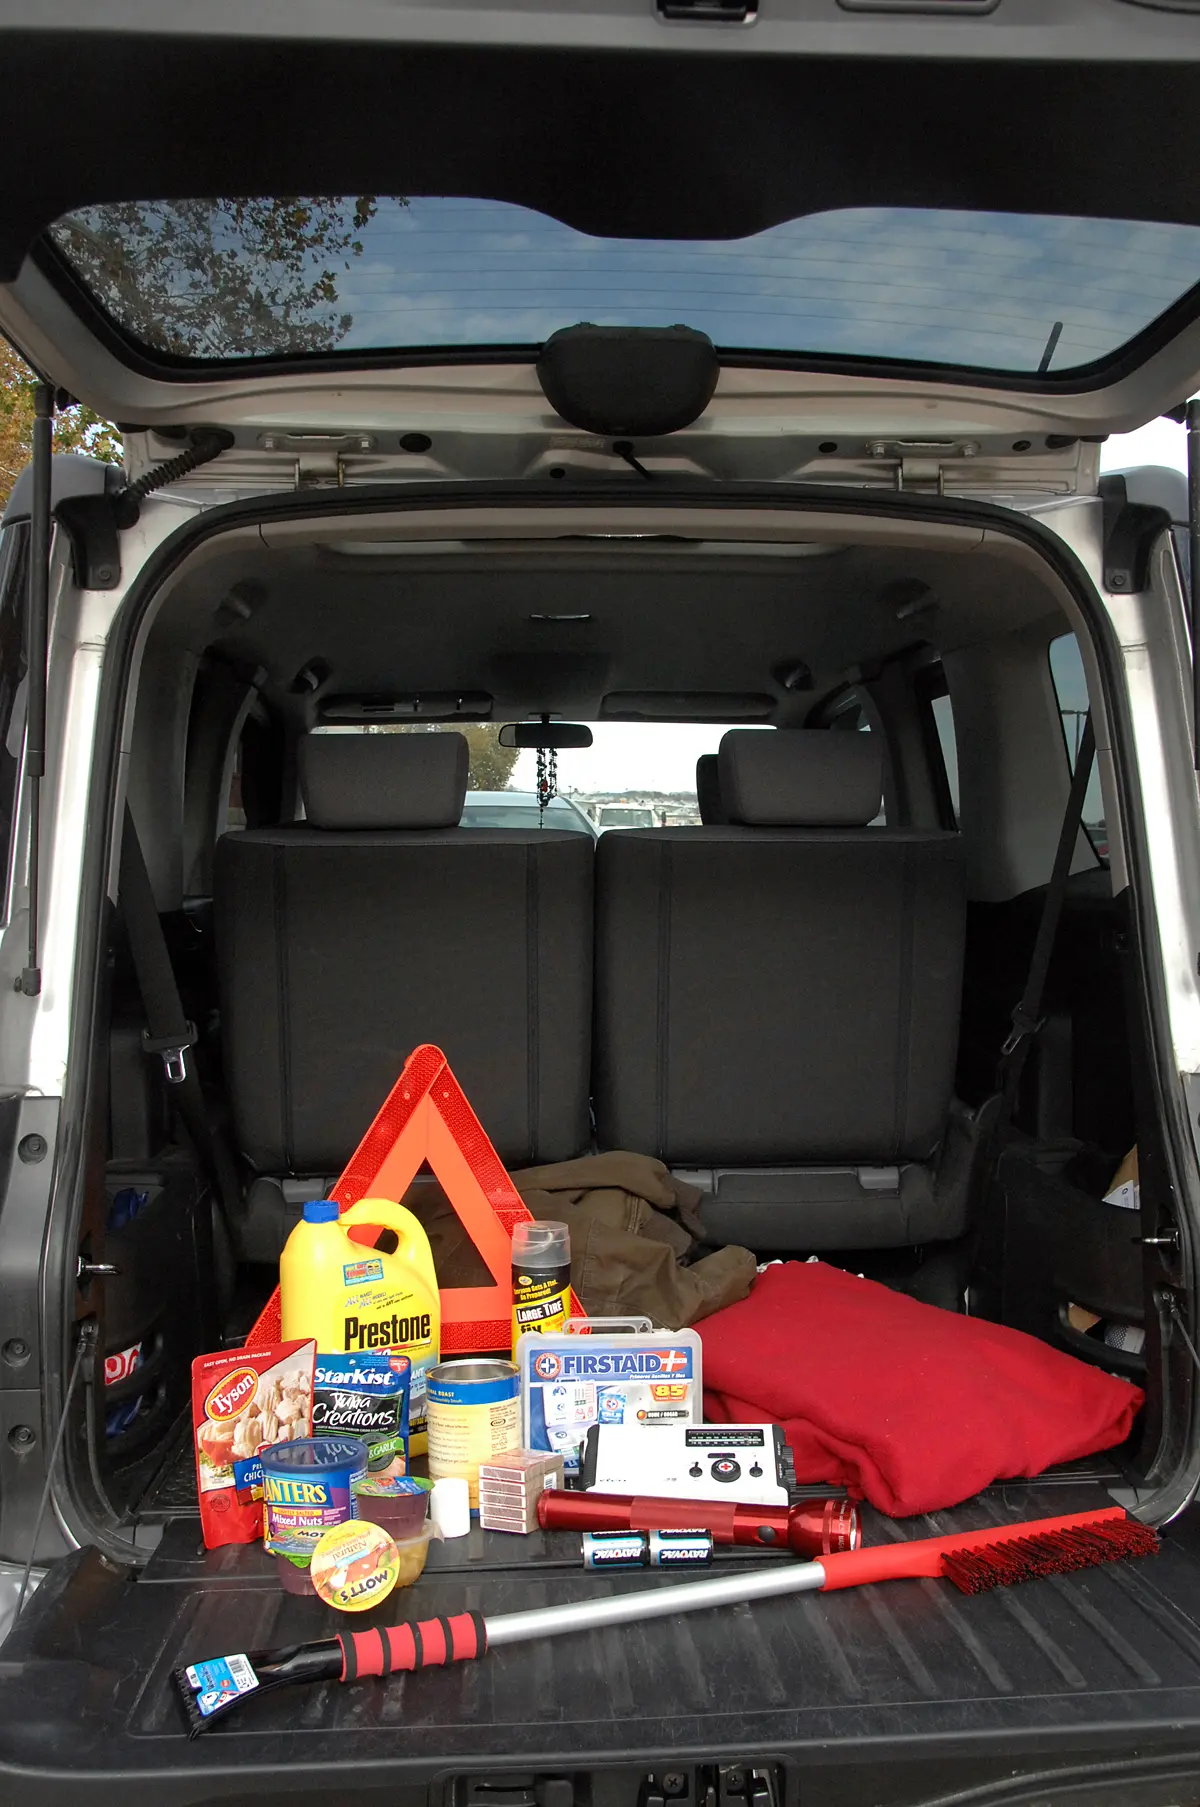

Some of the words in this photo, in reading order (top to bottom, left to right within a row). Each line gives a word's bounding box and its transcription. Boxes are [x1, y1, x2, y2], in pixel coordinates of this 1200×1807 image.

[518, 1308, 543, 1322] LARGE
[543, 1300, 562, 1316] TIRE
[344, 1314, 430, 1350] Prestone
[314, 1368, 393, 1385] StarKist
[410, 1366, 425, 1380] ANT
[210, 1375, 254, 1414] Tyson
[656, 1386, 684, 1397] 85
[330, 1392, 372, 1411] Tuna
[312, 1402, 394, 1426] Creations
[374, 1440, 397, 1456] GARLIC
[244, 1470, 263, 1482] CHIC
[264, 1478, 327, 1504] ANTERS
[272, 1513, 297, 1526] Mixed
[298, 1515, 323, 1526] Nuts
[333, 1540, 367, 1561] Natural
[594, 1548, 641, 1559] RAYOVAC
[661, 1548, 708, 1559] RAYOVAC
